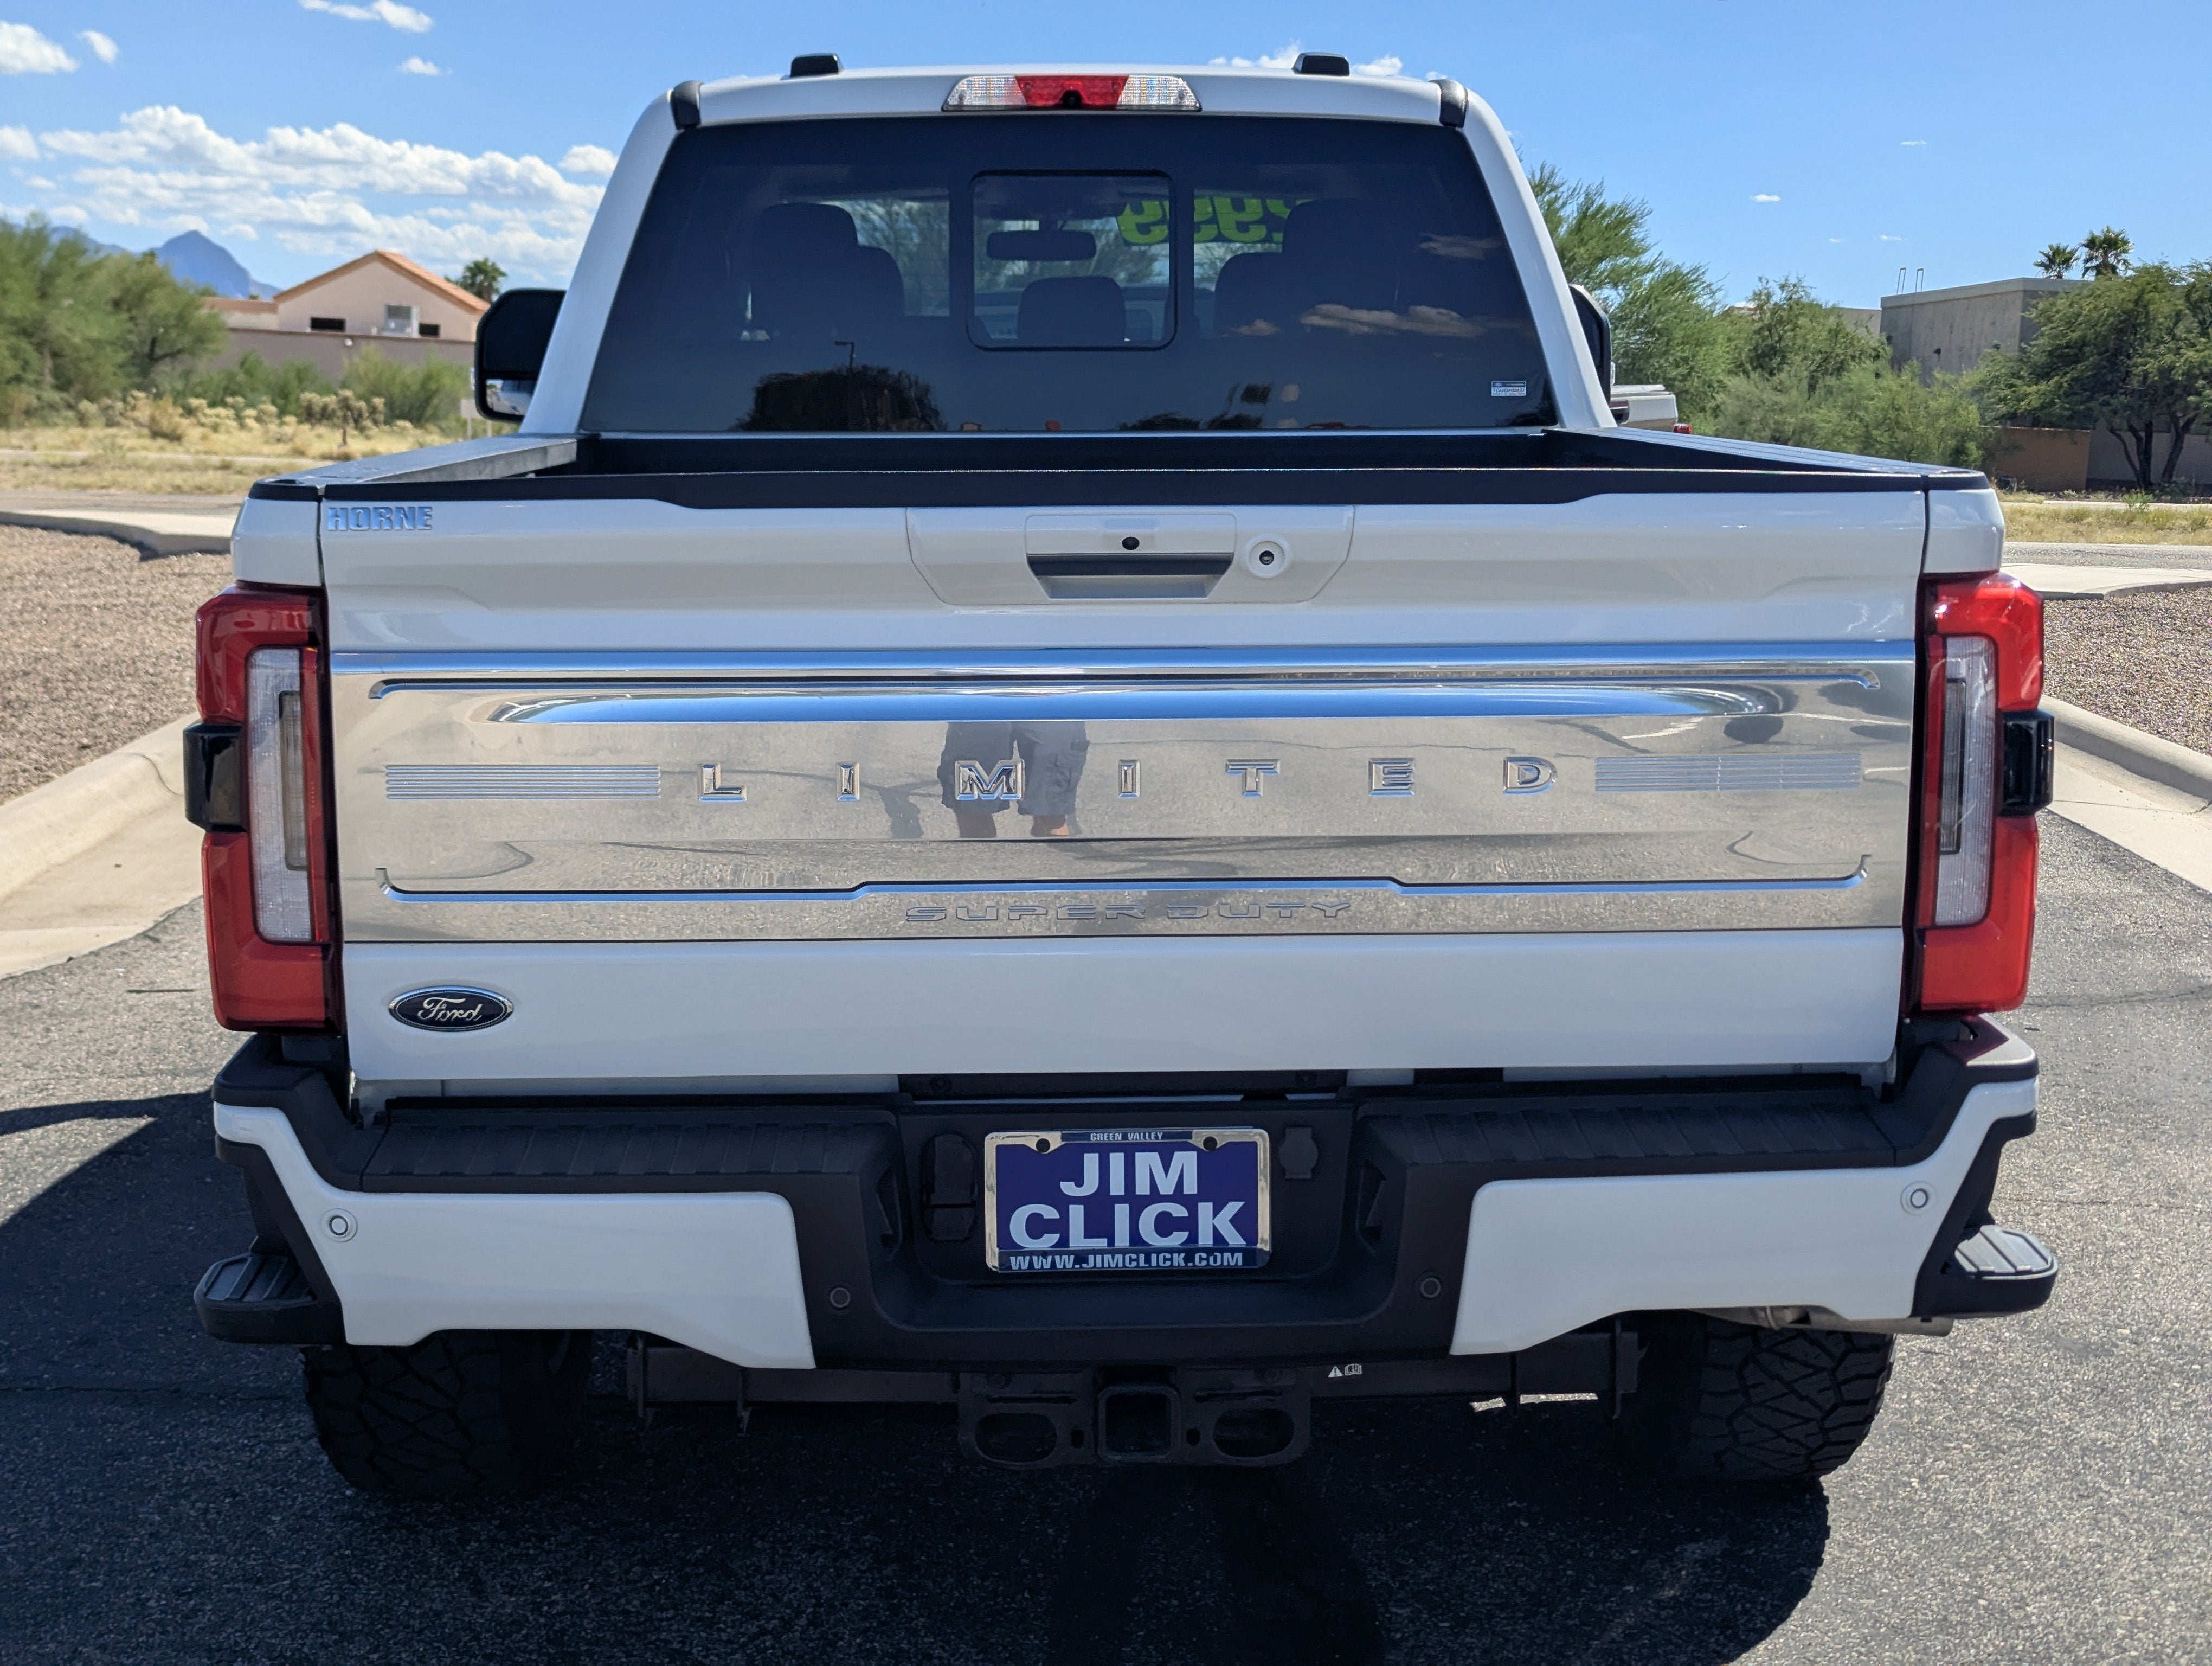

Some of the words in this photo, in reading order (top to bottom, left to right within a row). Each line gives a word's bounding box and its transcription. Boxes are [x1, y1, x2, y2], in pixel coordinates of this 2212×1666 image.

[327, 506, 433, 531] HORNE
[697, 756, 1558, 803] LIMITED
[906, 904, 1146, 921] SUPER
[1167, 902, 1351, 919] DUTY
[417, 997, 483, 1021] Ford
[1090, 1132, 1122, 1141] GREEN
[1127, 1132, 1163, 1140] VALLEY
[1059, 1151, 1198, 1196] JIM
[1009, 1201, 1246, 1248] CLICK
[1009, 1252, 1243, 1270] WWW.JIMCLICK.COM
